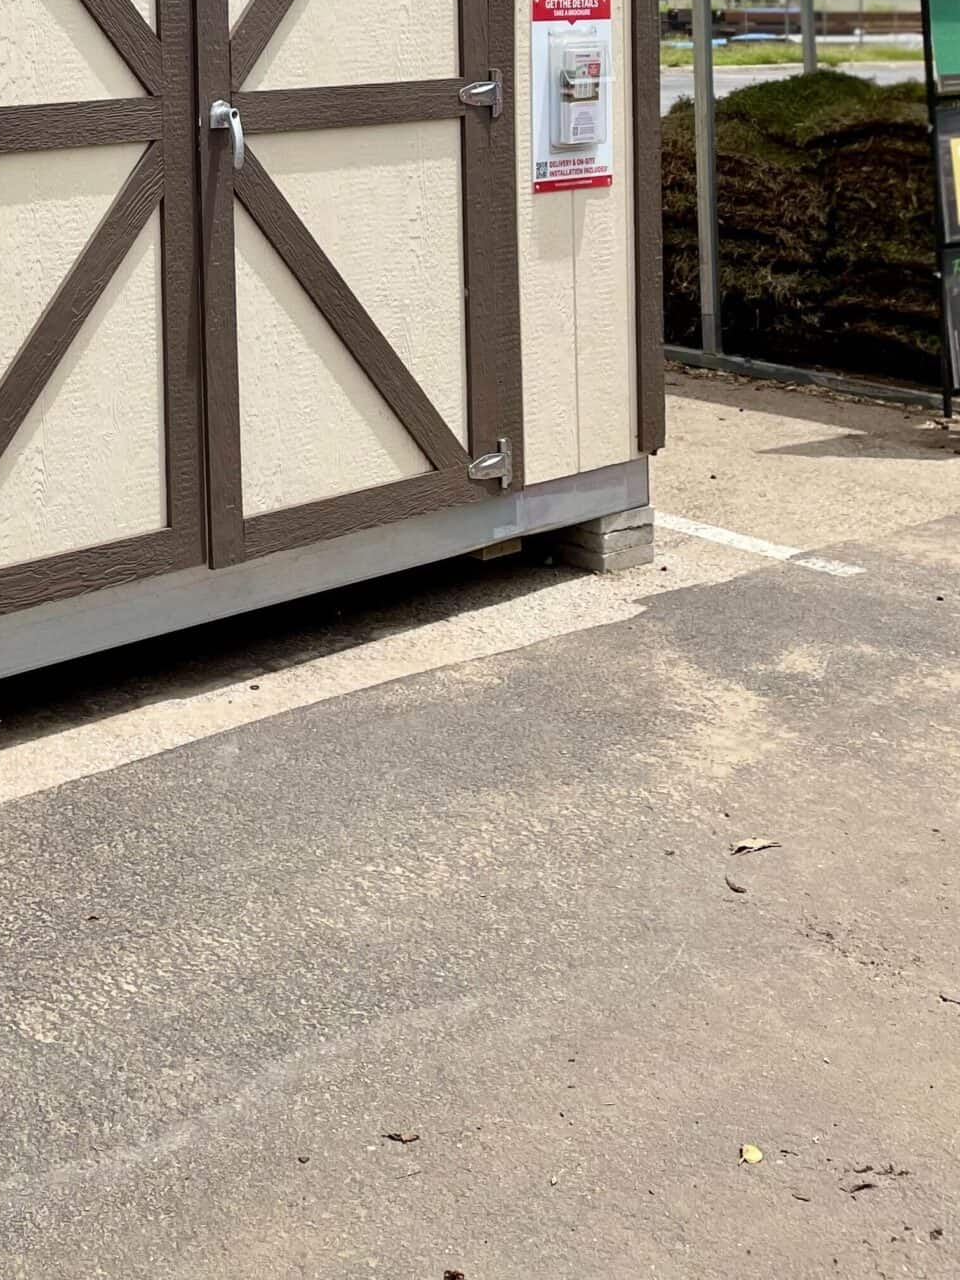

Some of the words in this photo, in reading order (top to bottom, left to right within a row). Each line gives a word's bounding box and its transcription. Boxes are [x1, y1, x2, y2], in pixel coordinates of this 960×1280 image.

[544, 0, 558, 9] GET
[549, 159, 572, 168] DELIVERY
[549, 167, 583, 177] INSTALLATION
